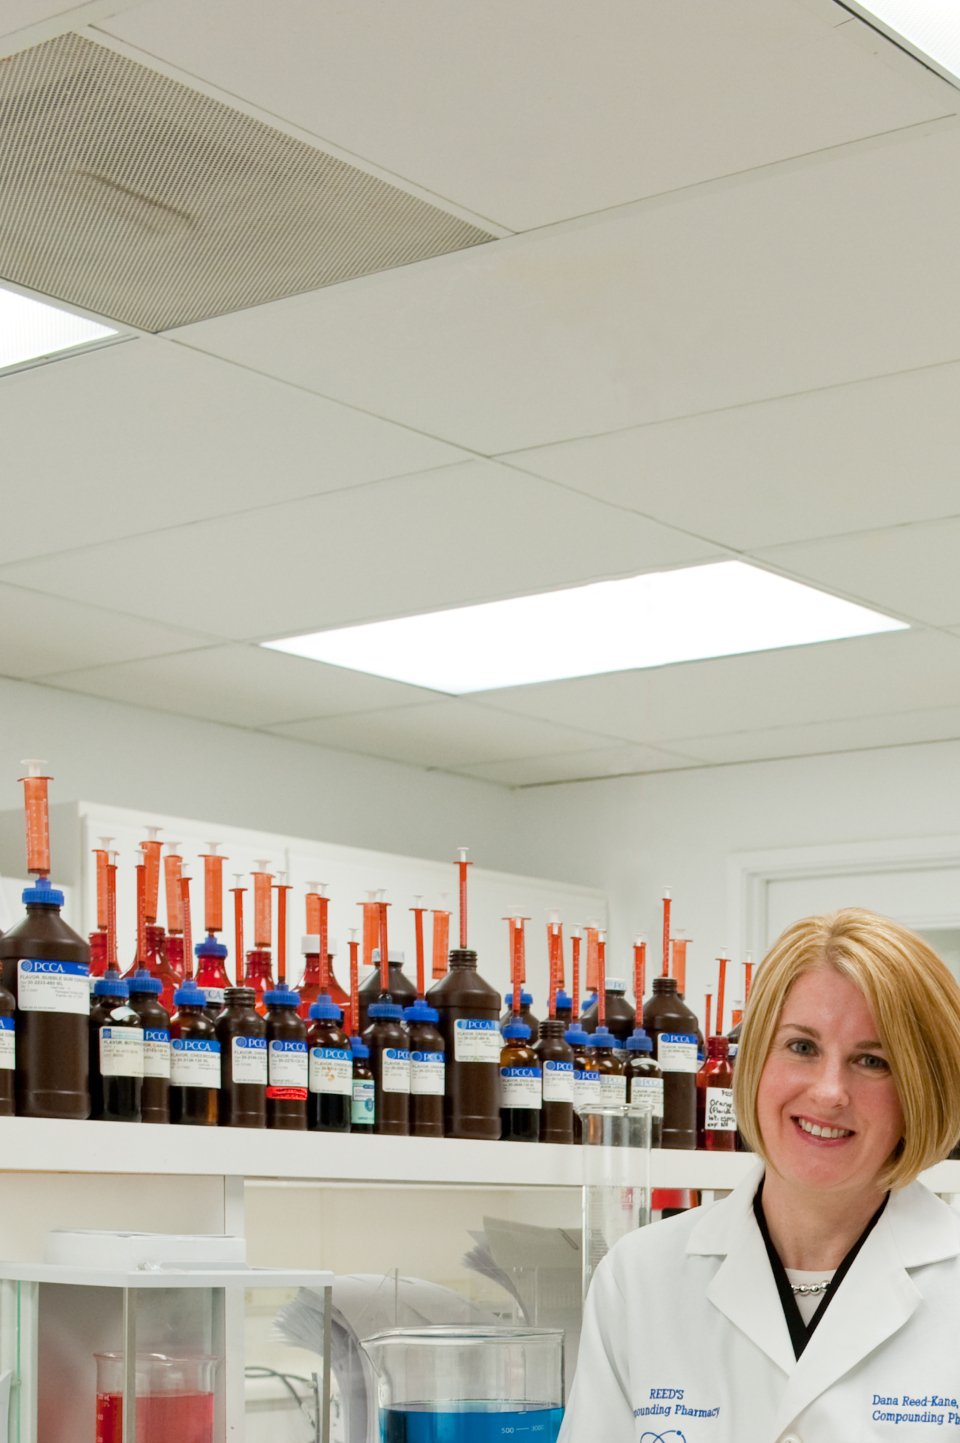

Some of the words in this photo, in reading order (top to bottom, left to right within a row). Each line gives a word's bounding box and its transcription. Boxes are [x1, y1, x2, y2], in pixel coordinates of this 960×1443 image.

[34, 961, 65, 973] PCCA
[469, 1020, 491, 1029] PCCA
[671, 1035, 690, 1043] PCCA
[184, 1041, 212, 1051] PCCA
[325, 1048, 349, 1060] PCCA
[511, 1068, 534, 1077] PCCA
[649, 1388, 685, 1400] REED'S
[872, 1394, 899, 1405] Dana
[902, 1395, 959, 1409] Reed-Kane,
[675, 1404, 720, 1418] Pharmacy
[872, 1410, 945, 1425] Compounding
